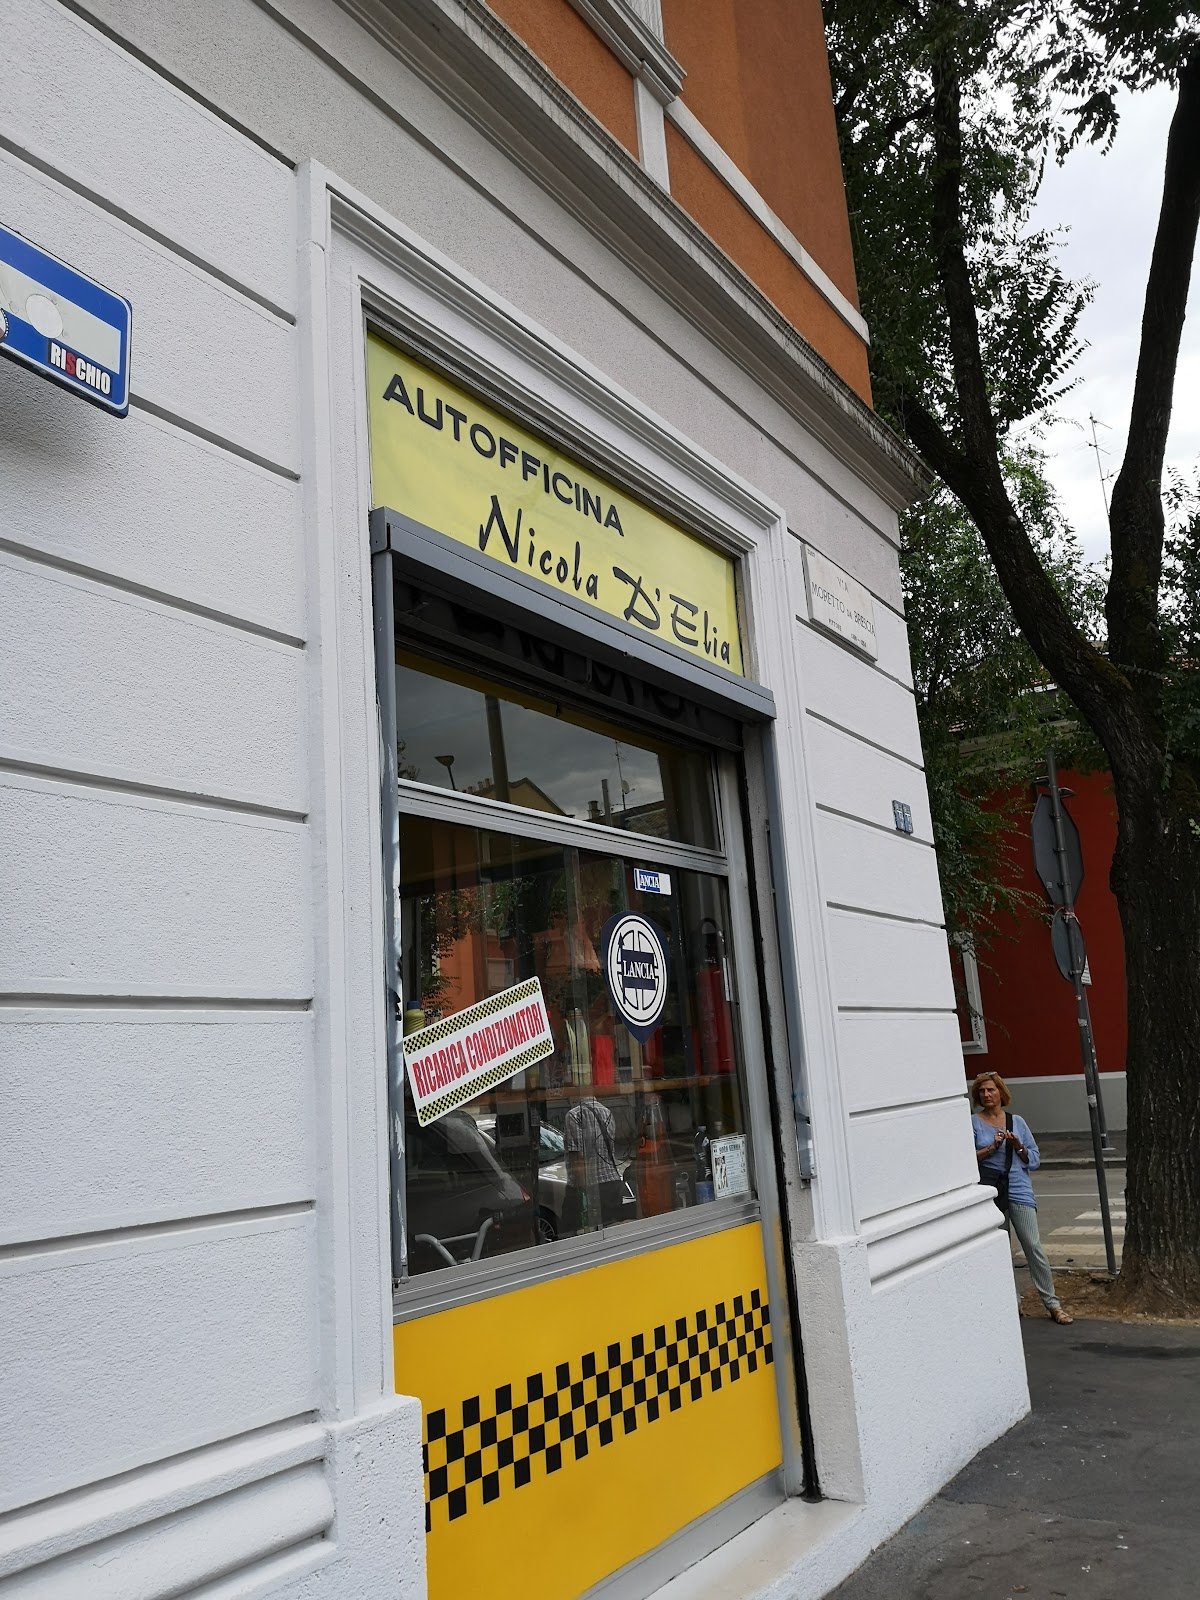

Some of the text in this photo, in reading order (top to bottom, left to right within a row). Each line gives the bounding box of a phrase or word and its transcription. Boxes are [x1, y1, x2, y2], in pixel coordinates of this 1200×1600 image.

[50, 342, 111, 395] RISCHIO
[382, 373, 625, 537] AUTOFFICINA
[478, 495, 598, 600] Nicola
[612, 566, 731, 665] D'Elia
[837, 577, 849, 593] VIA
[811, 581, 876, 637] MORETTO DA BRESCIA
[637, 869, 661, 891] LANCIA
[623, 960, 655, 980] LANCIA
[412, 1001, 546, 1099] RICARICA CONDIZIONATORI
